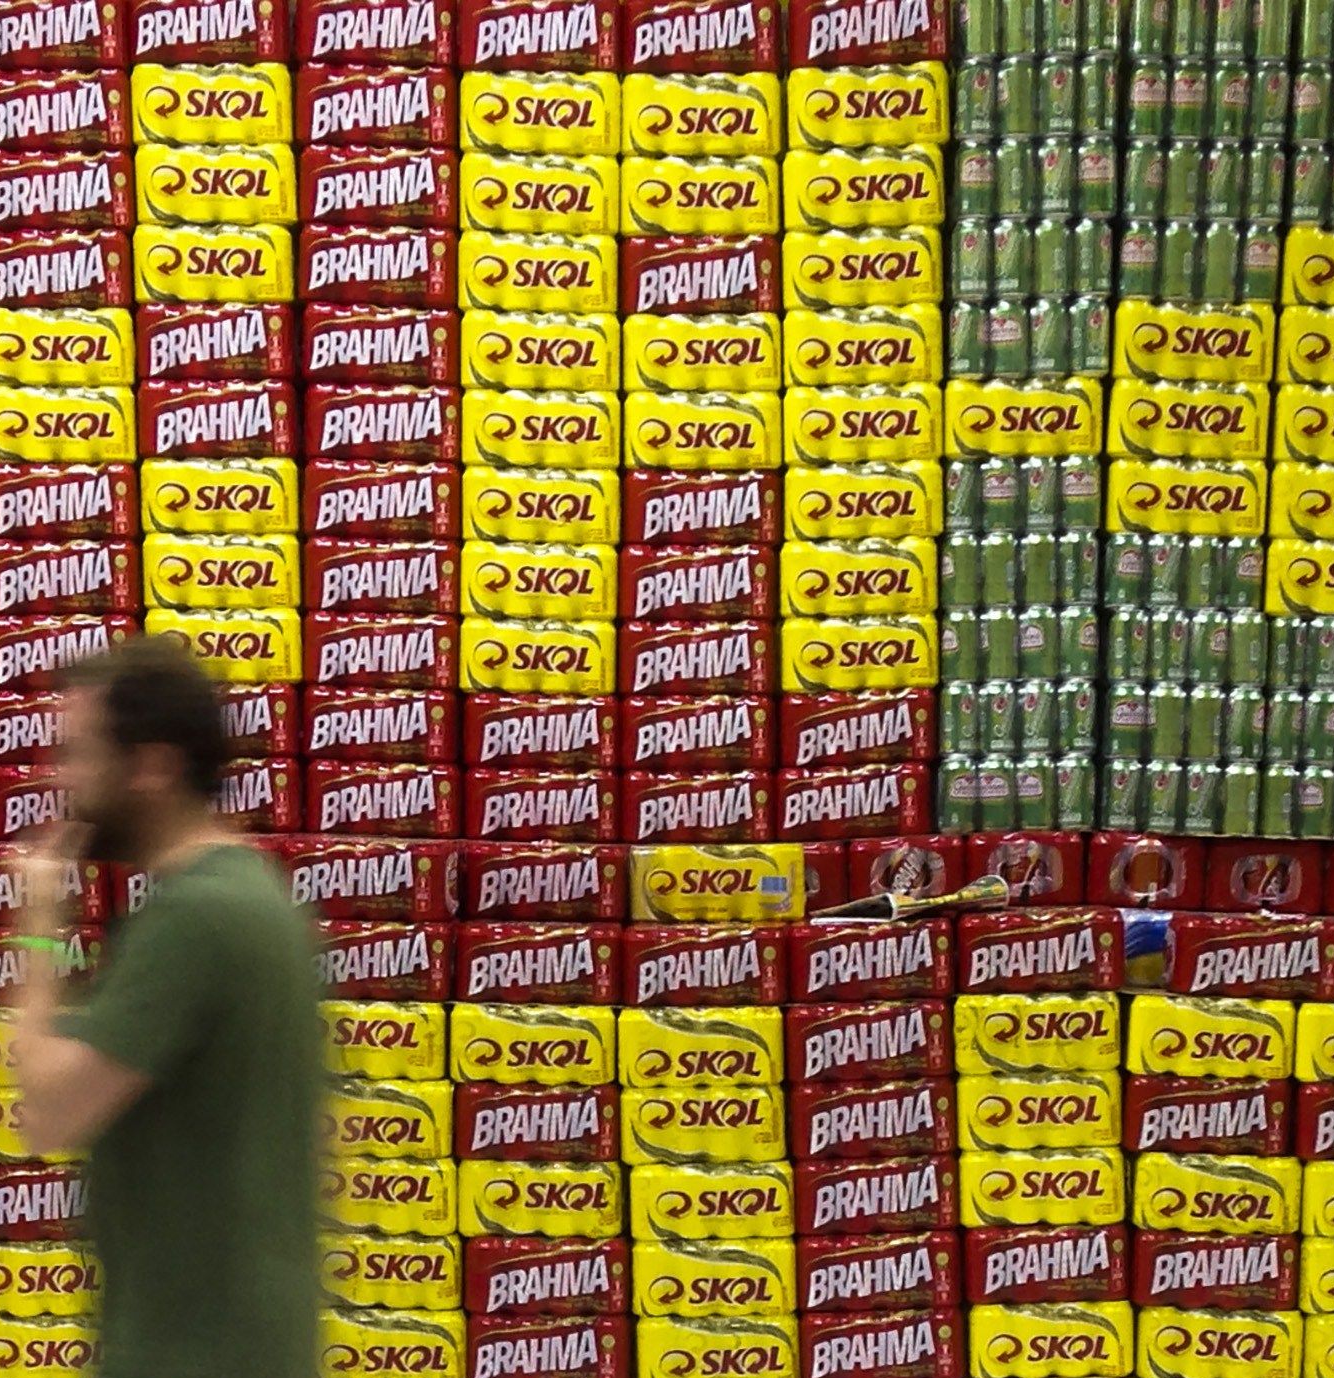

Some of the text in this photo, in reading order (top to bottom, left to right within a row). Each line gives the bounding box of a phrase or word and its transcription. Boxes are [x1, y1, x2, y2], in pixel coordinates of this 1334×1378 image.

[634, 3, 755, 64] BRAHMA
[312, 77, 429, 139] BRAHMA
[513, 182, 593, 214] SKOL
[848, 173, 929, 202] SKOL
[187, 247, 266, 278] SKOL
[310, 323, 429, 369] BRAHMA
[684, 338, 764, 366] SKOL
[1173, 326, 1252, 358] SKOL
[34, 413, 114, 440] SKOL
[522, 416, 601, 444] SKOL
[1004, 406, 1080, 434] SKOL
[195, 485, 274, 512] SKOL
[840, 491, 915, 518] SKOL
[1167, 485, 1247, 513] SKOL
[322, 553, 437, 608] BRAHMA
[636, 557, 751, 617] BRAHMA
[196, 632, 274, 660] SKOL
[481, 708, 599, 761] BRAHMA
[797, 703, 912, 765] BRAHMA
[291, 851, 413, 906] BRAHMA
[683, 869, 755, 895] SKOL
[469, 939, 593, 995] BRAHMA
[969, 928, 1095, 985] BRAHMA
[1190, 937, 1319, 991] BRAHMA
[333, 1018, 418, 1049] SKOL
[805, 1010, 926, 1078] BRAHMA
[472, 1097, 598, 1150] BRAHMA
[682, 1099, 763, 1127] SKOL
[1139, 1095, 1267, 1149] BRAHMA
[351, 1173, 433, 1203] SKOL
[1023, 1170, 1104, 1198] SKOL
[487, 1255, 609, 1312] BRAHMA
[808, 1248, 932, 1307] BRAHMA
[703, 1347, 784, 1375] SKOL
[1196, 1330, 1278, 1361] SKOL
